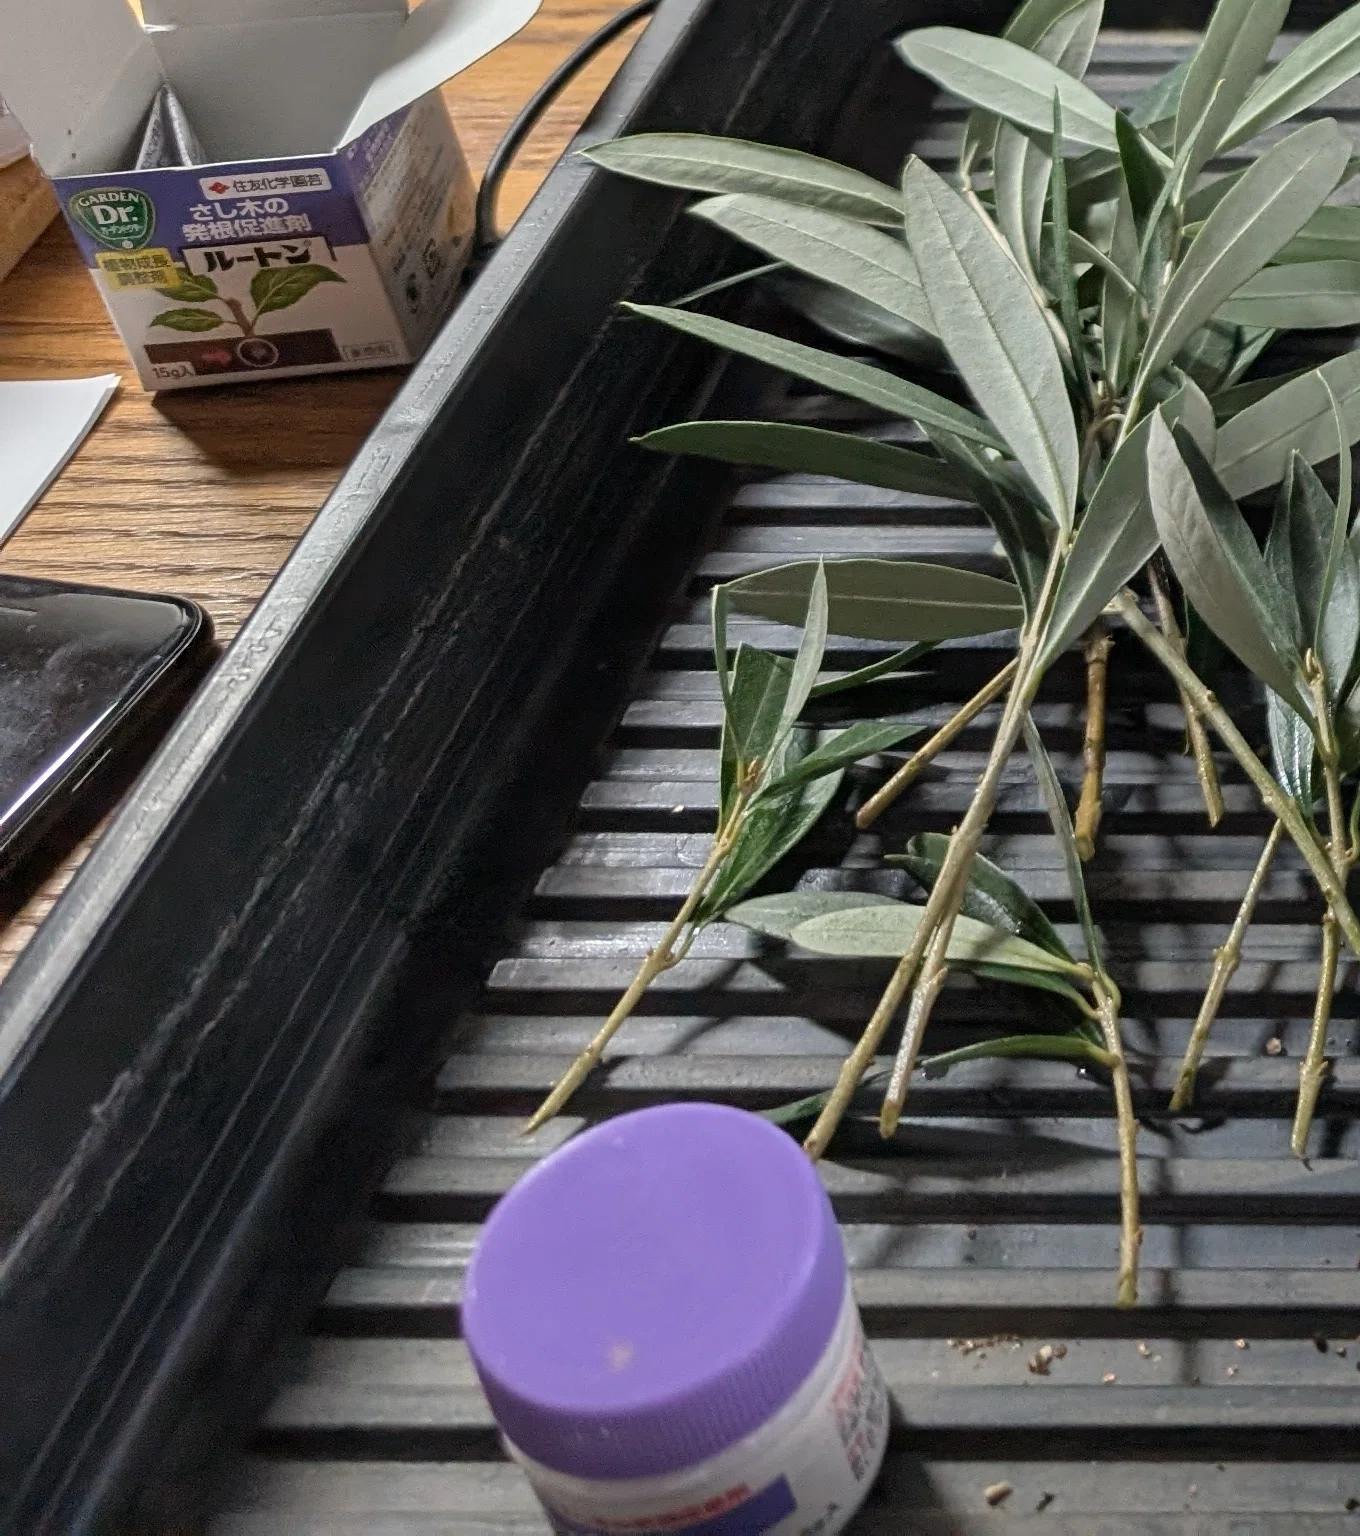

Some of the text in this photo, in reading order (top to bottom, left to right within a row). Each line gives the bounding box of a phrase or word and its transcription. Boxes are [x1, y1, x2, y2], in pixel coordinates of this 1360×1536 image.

[233, 173, 323, 193] 住友化学園芸
[79, 192, 140, 207] GARDEN
[189, 197, 290, 221] さし木の
[91, 205, 138, 224] Dr.
[181, 213, 312, 242] 発根促進剤
